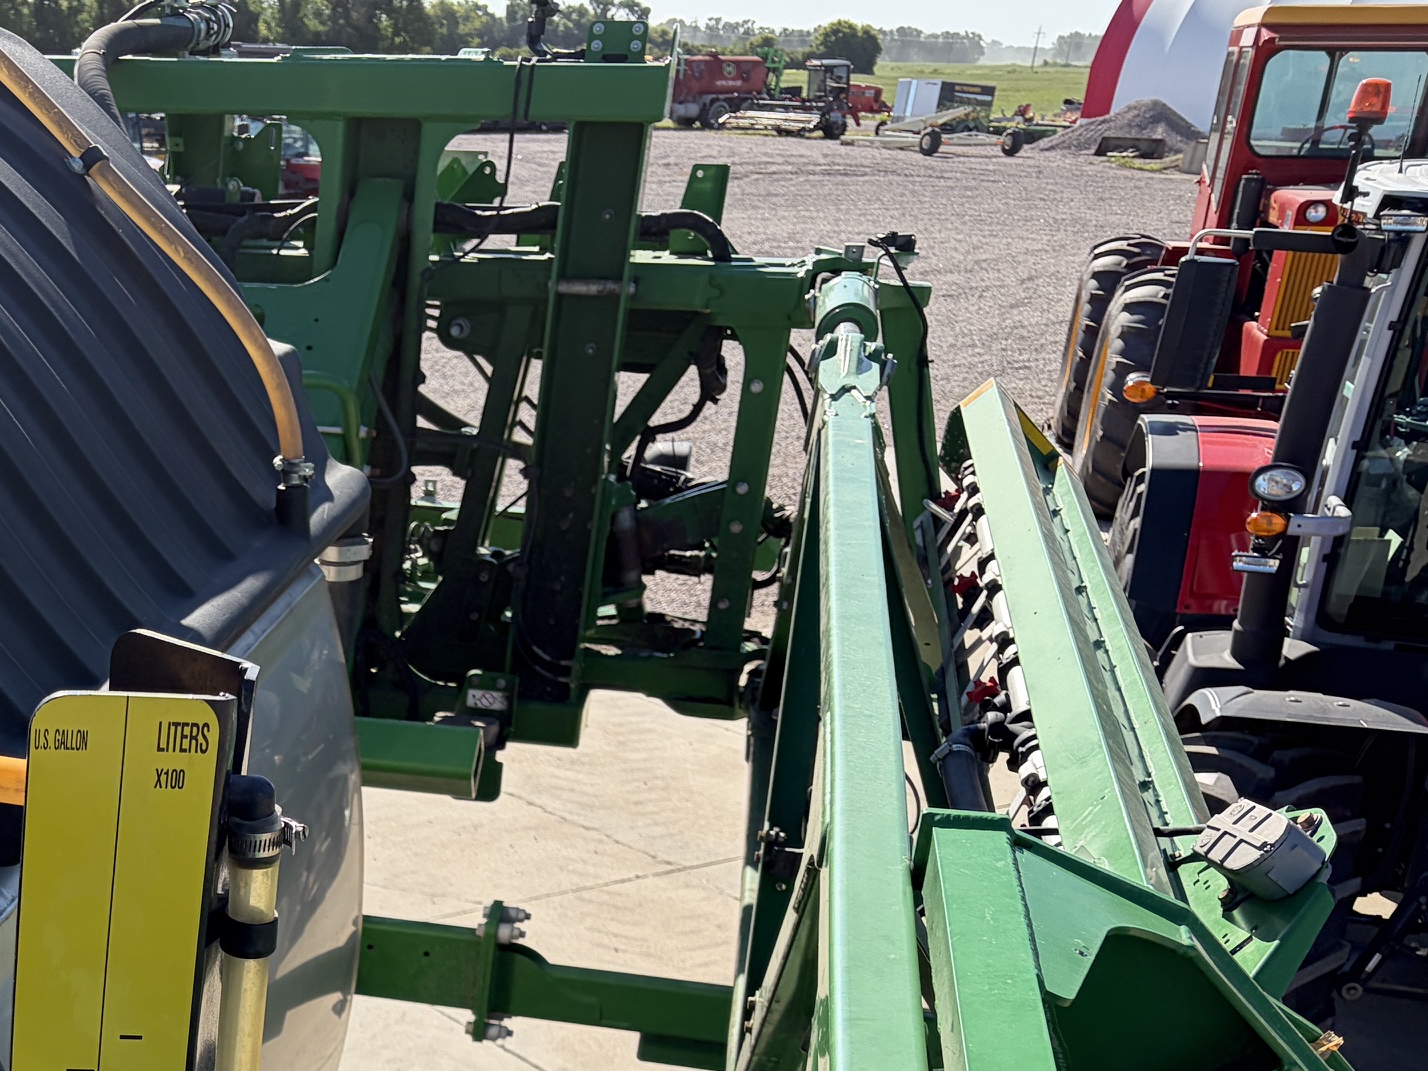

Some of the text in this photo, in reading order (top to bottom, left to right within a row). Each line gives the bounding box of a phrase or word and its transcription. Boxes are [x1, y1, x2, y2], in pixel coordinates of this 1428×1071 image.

[34, 729, 89, 752] U.S. GALLON
[156, 721, 210, 754] LITERS
[153, 768, 185, 790] X100
